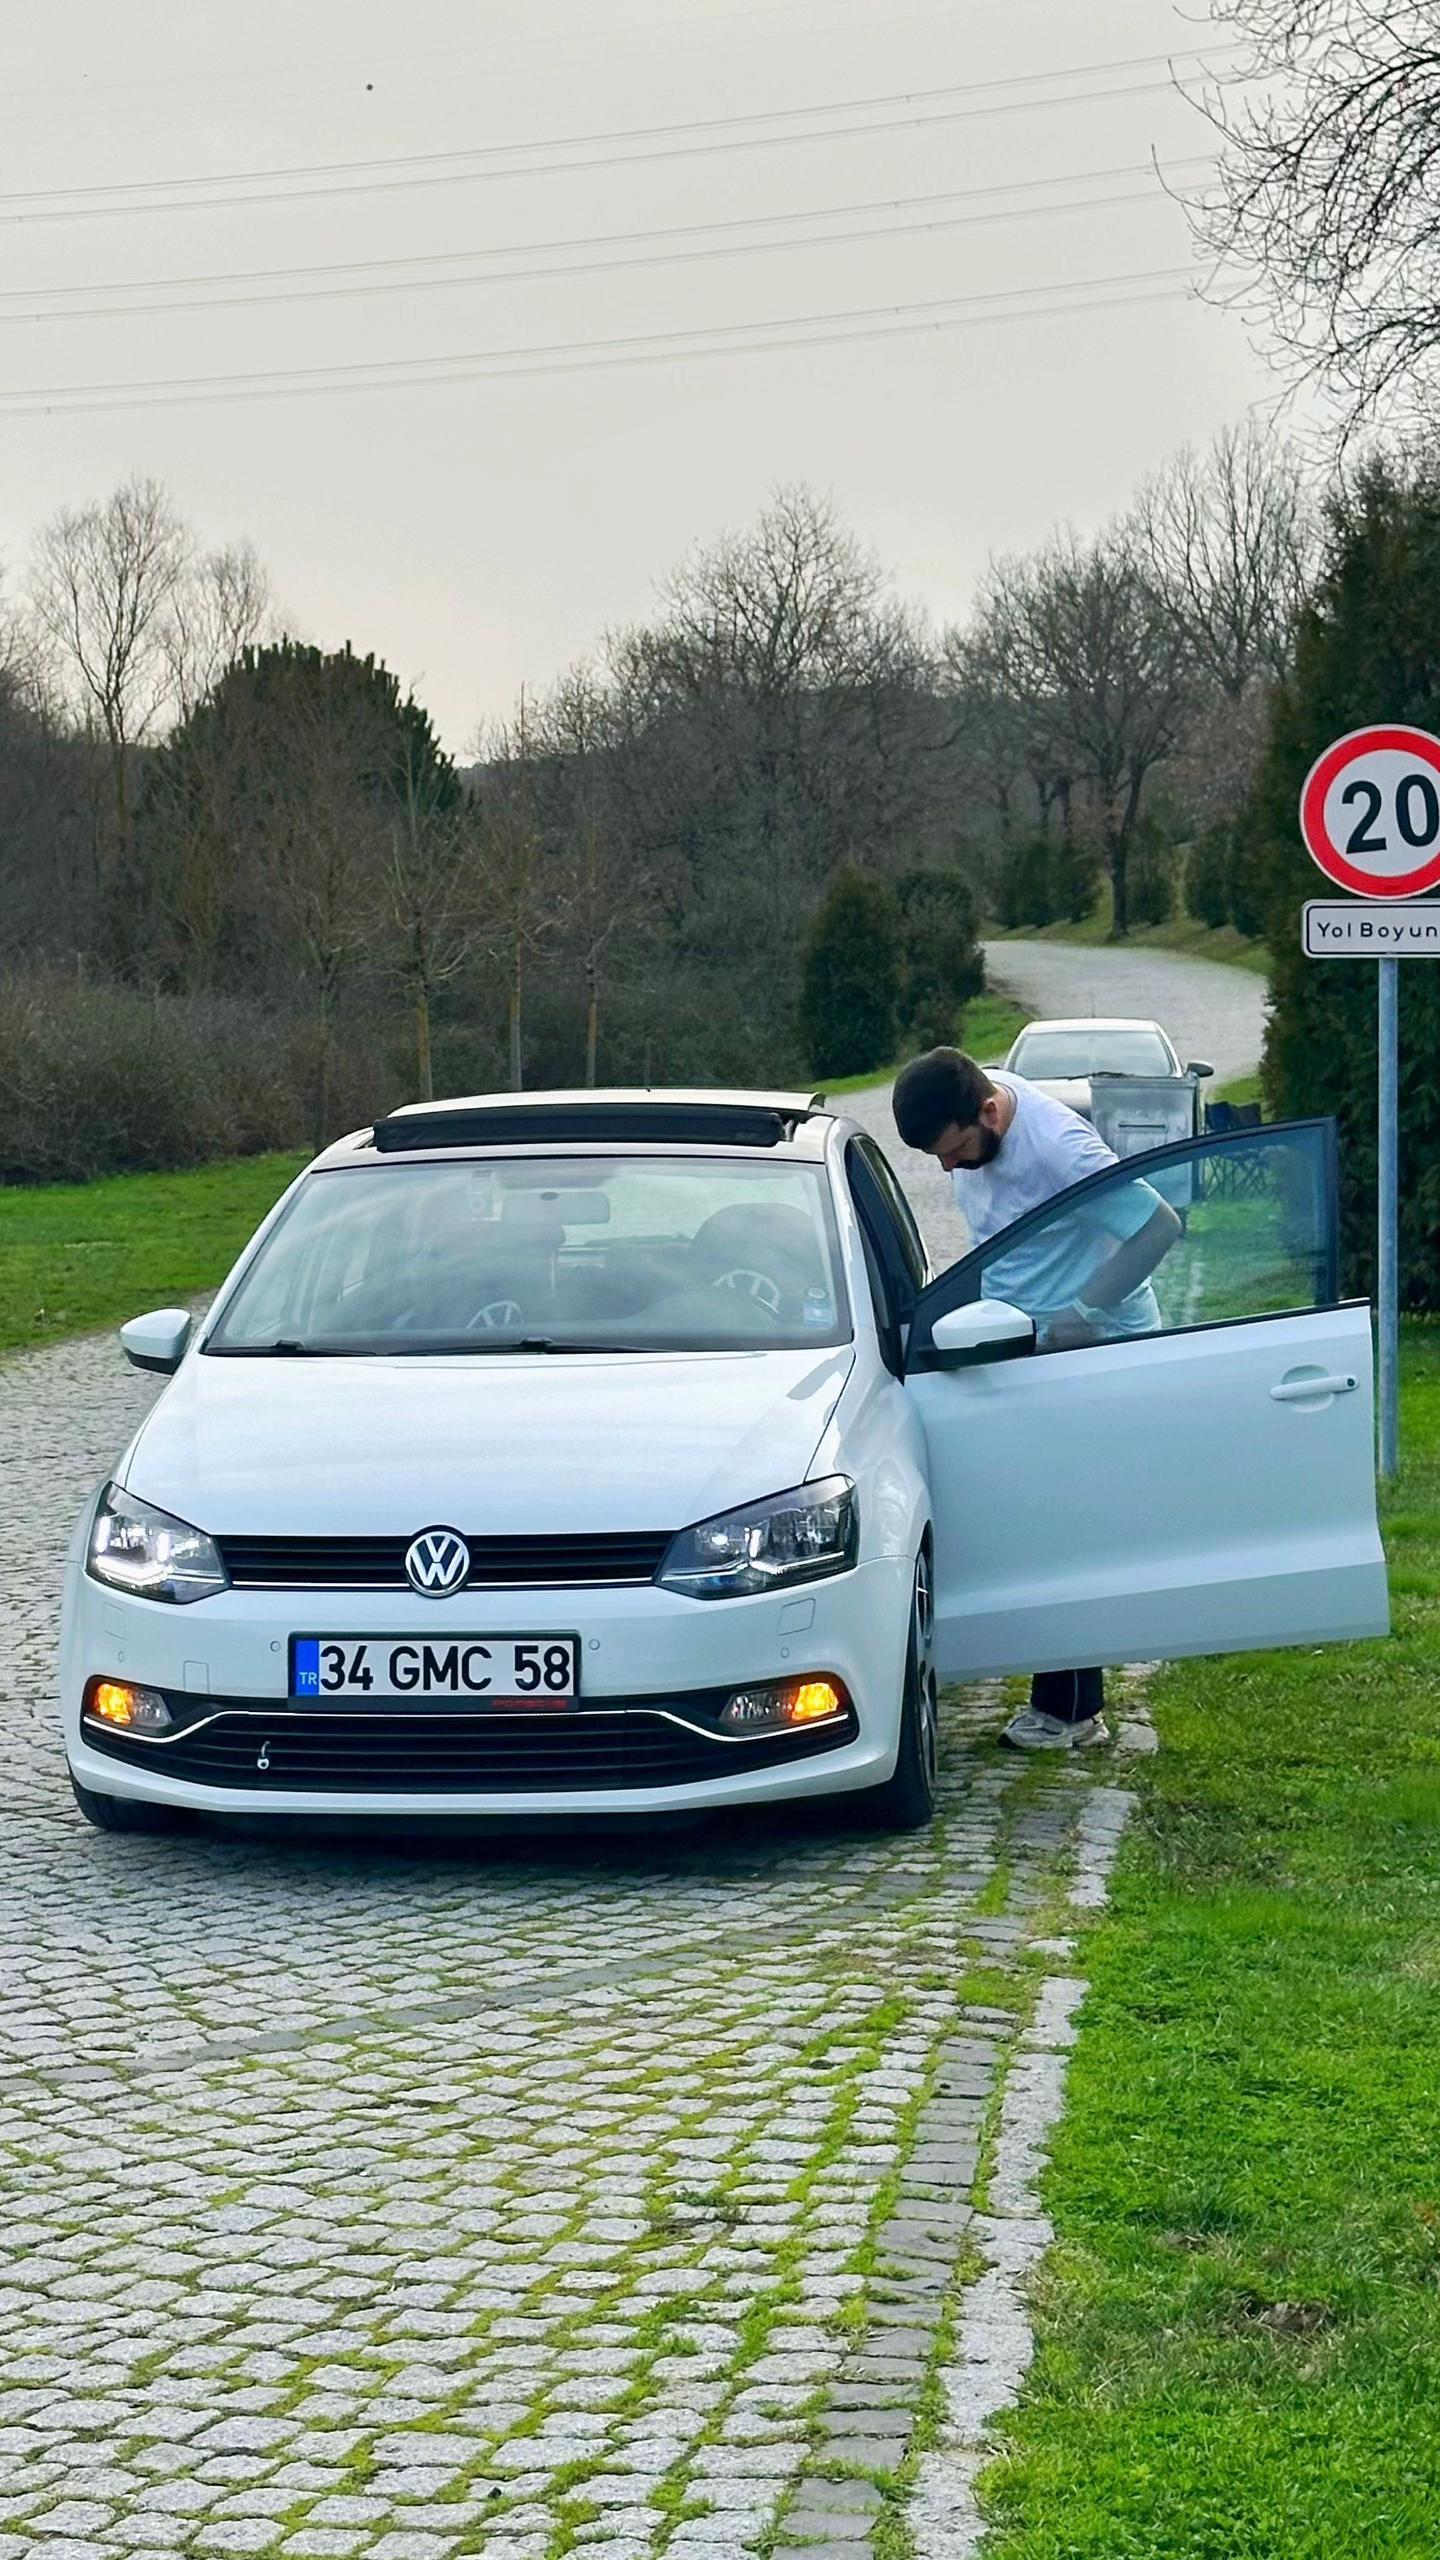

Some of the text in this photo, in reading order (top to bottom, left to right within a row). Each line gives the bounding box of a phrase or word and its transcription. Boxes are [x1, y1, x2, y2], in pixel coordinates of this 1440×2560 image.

[1341, 774, 1439, 854] 20
[1317, 922, 1438, 942] Yol Boyun
[406, 1532, 468, 1594] VW
[299, 1645, 571, 1691] TR 34 GMC 58
